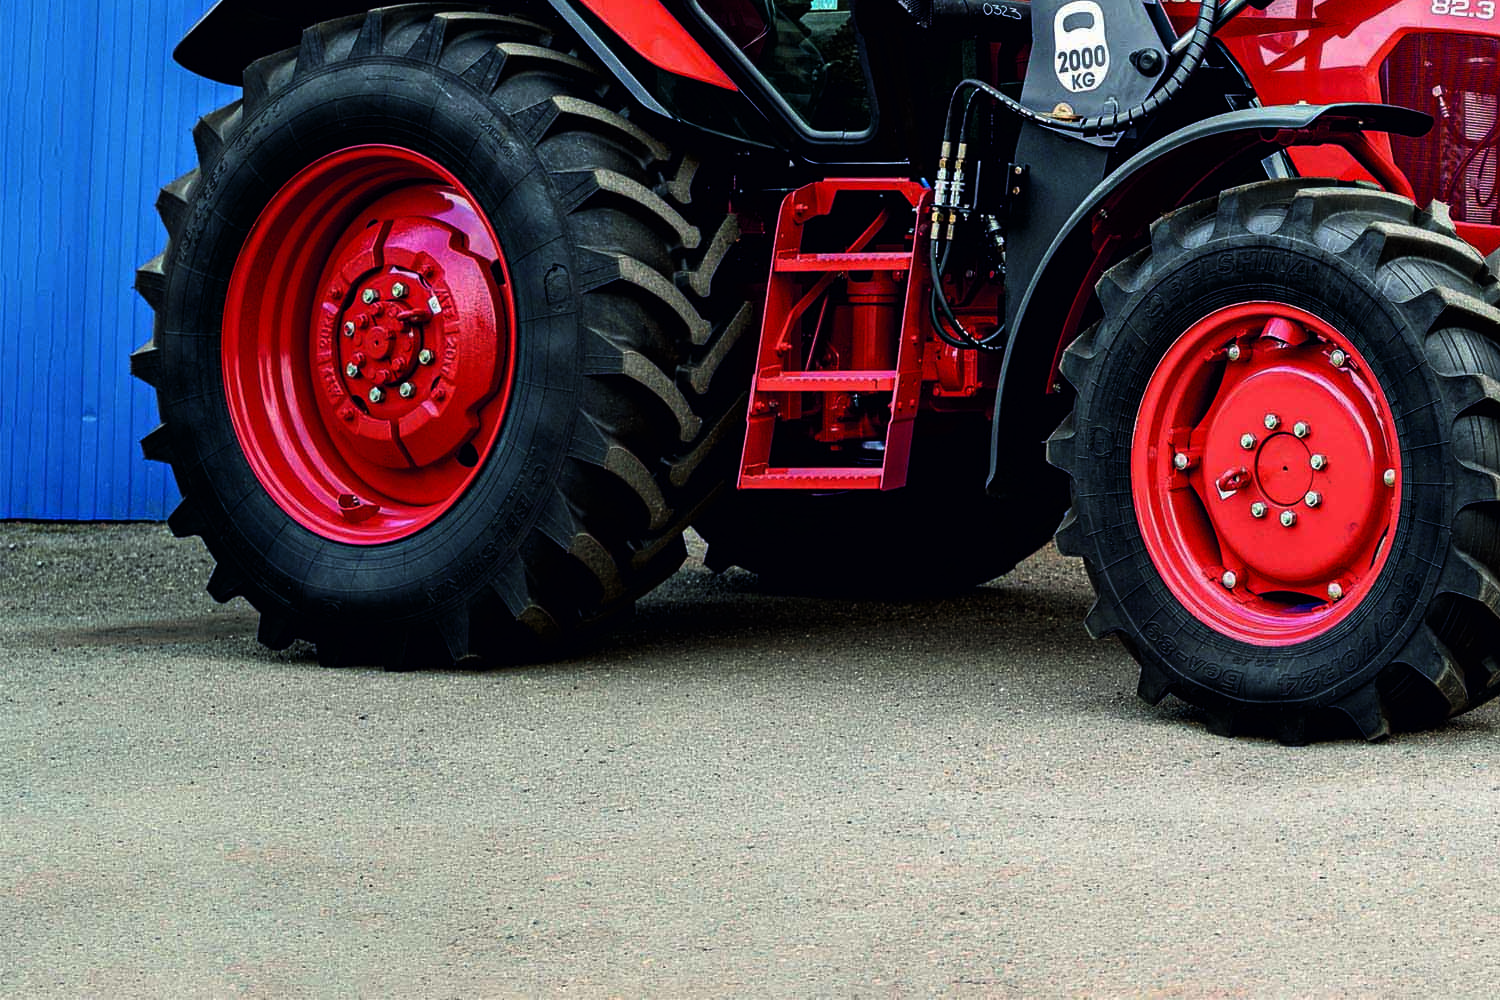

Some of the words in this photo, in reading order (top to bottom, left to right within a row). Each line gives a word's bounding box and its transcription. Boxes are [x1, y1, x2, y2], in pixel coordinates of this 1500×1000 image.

[982, 2, 1022, 20] 0323
[1057, 45, 1106, 74] 2000
[1071, 73, 1096, 90] KG
